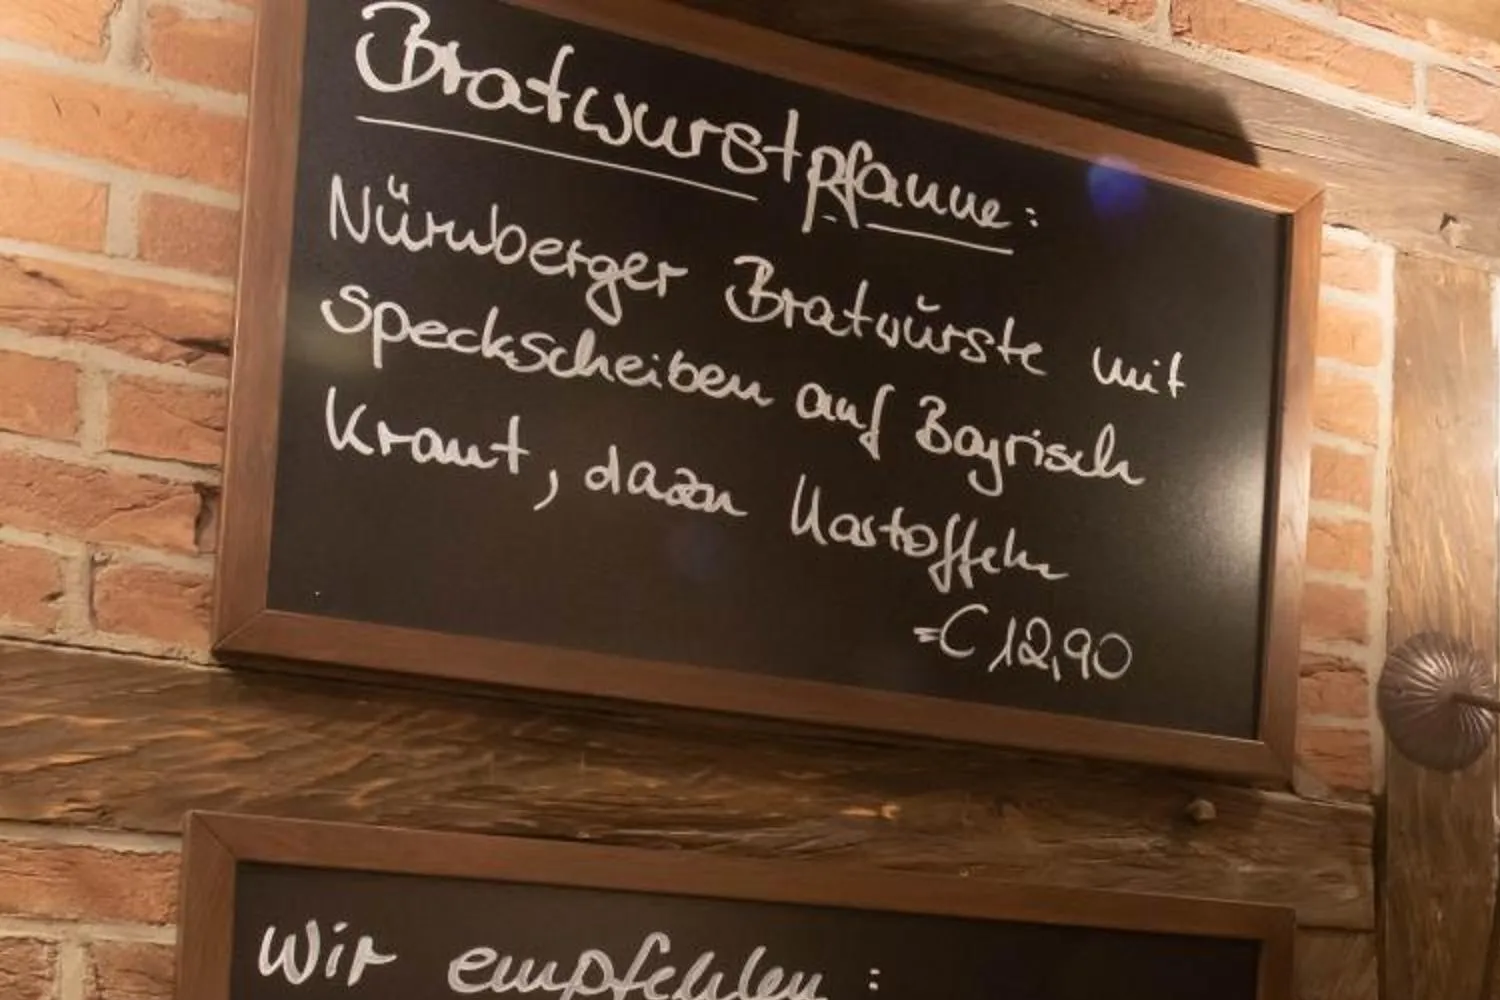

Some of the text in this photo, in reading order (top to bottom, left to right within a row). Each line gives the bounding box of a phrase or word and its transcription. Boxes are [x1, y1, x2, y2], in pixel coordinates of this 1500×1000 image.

[329, 173, 1187, 399] Nürnberger Bratwürste mit
[795, 382, 895, 460] auf
[915, 395, 1145, 497] Bayrisch
[584, 444, 748, 517] dazu
[790, 473, 1069, 594] Kartoffeln
[257, 919, 398, 987] Wir
